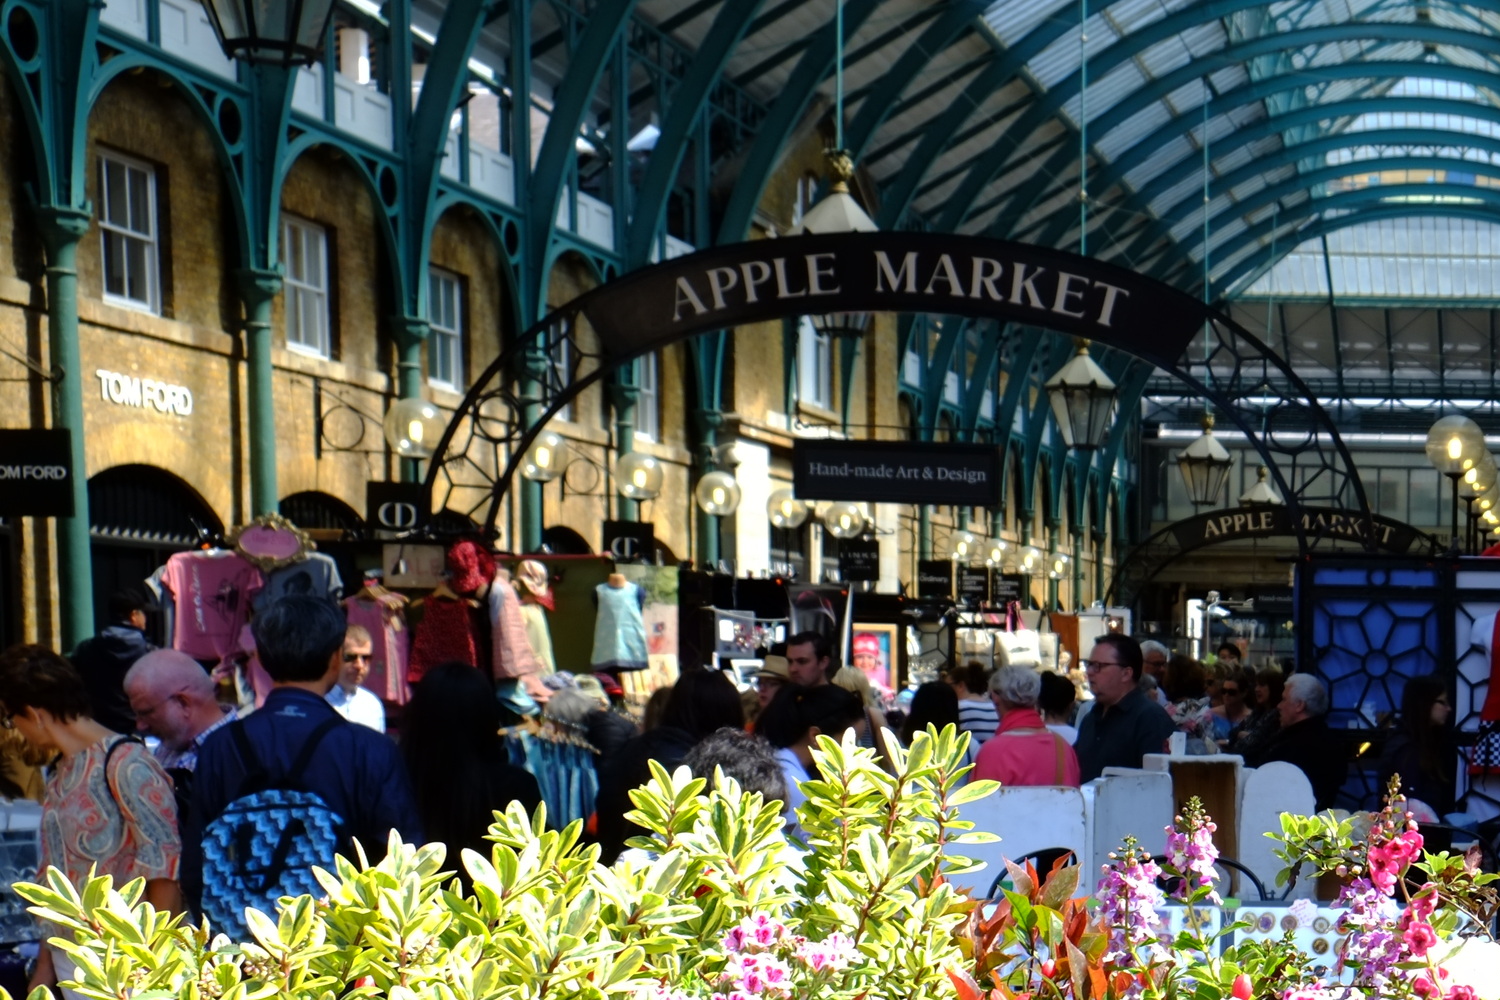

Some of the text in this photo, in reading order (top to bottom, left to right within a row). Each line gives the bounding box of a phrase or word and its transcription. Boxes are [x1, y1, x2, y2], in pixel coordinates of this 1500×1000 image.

[672, 251, 1130, 328] APPLE MARKET
[95, 369, 193, 416] TOM FORD
[0, 465, 67, 480] OM FORD
[809, 462, 987, 483] Hand-made Art & Design
[1205, 511, 1274, 538] APPLE
